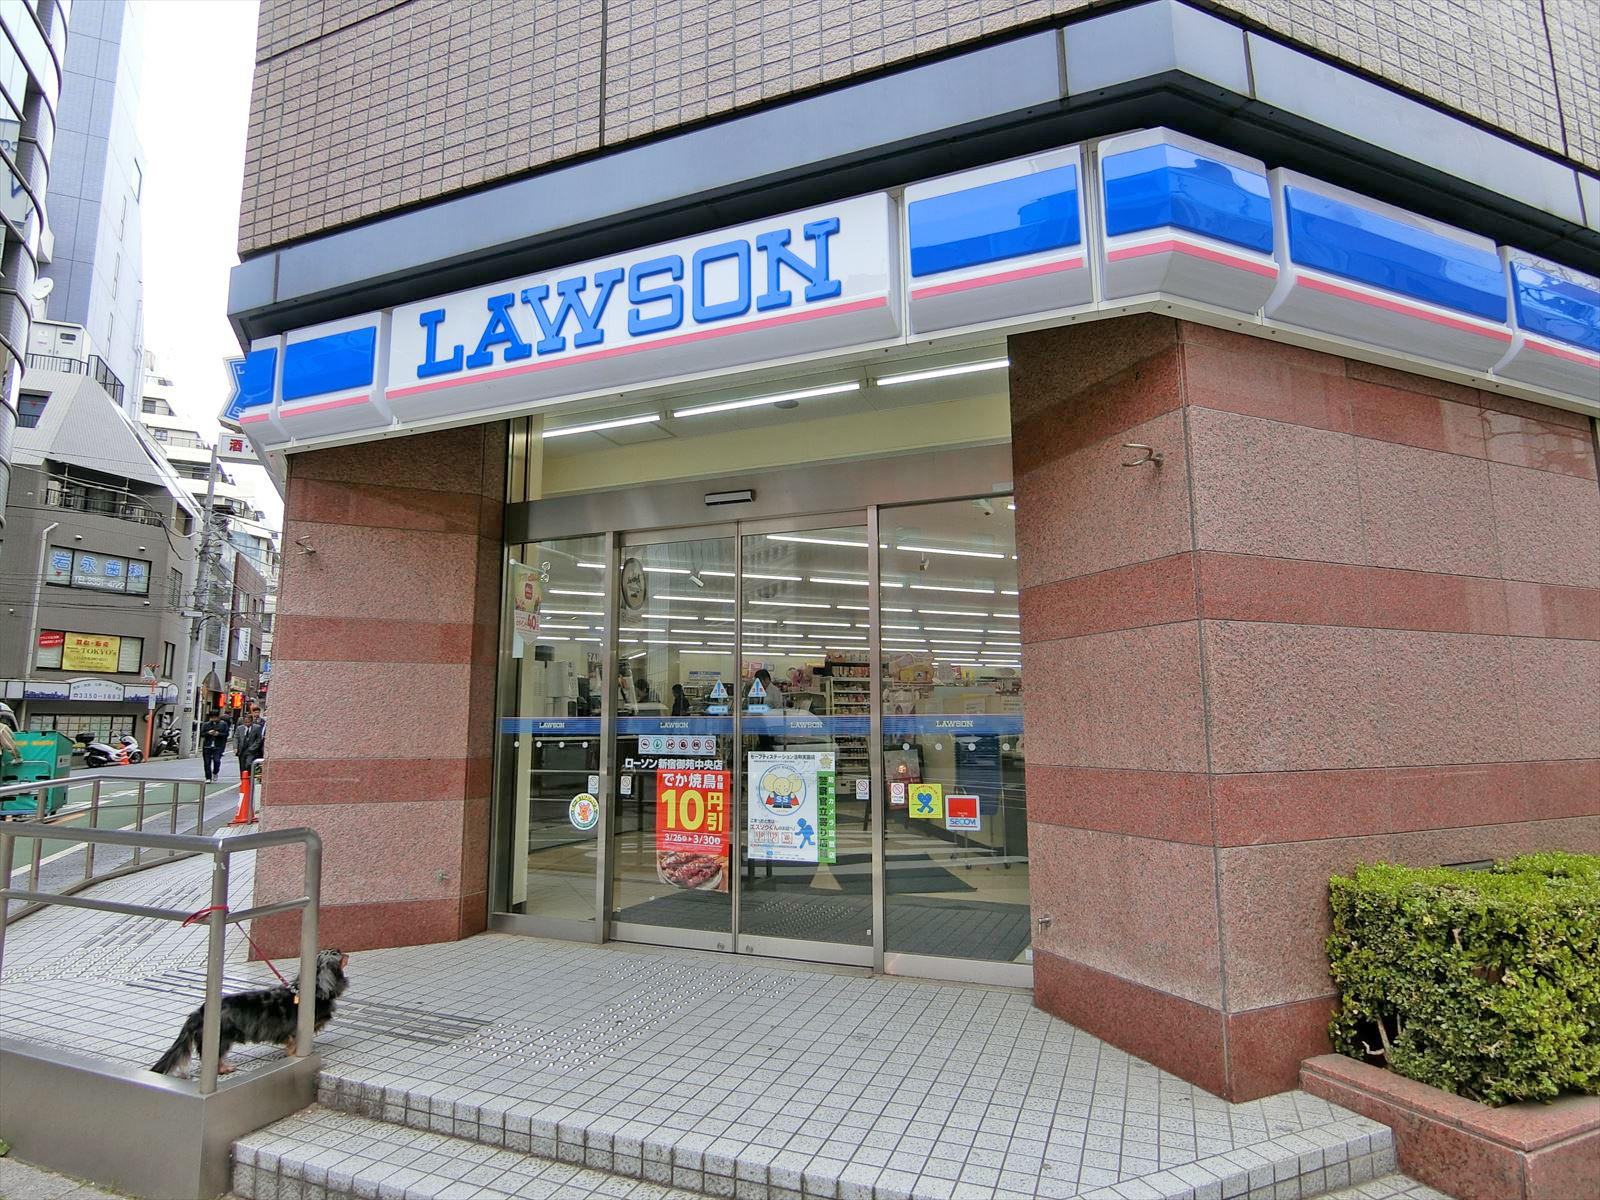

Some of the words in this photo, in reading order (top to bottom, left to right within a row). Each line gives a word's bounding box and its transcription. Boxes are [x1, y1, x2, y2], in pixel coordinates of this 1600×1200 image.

[416, 216, 842, 379] LAWSON
[659, 721, 689, 729] LAWSON
[790, 721, 824, 729] LAWSON
[935, 720, 974, 728] LAWSON
[661, 789, 705, 831] 10
[949, 818, 976, 826] SECOM
